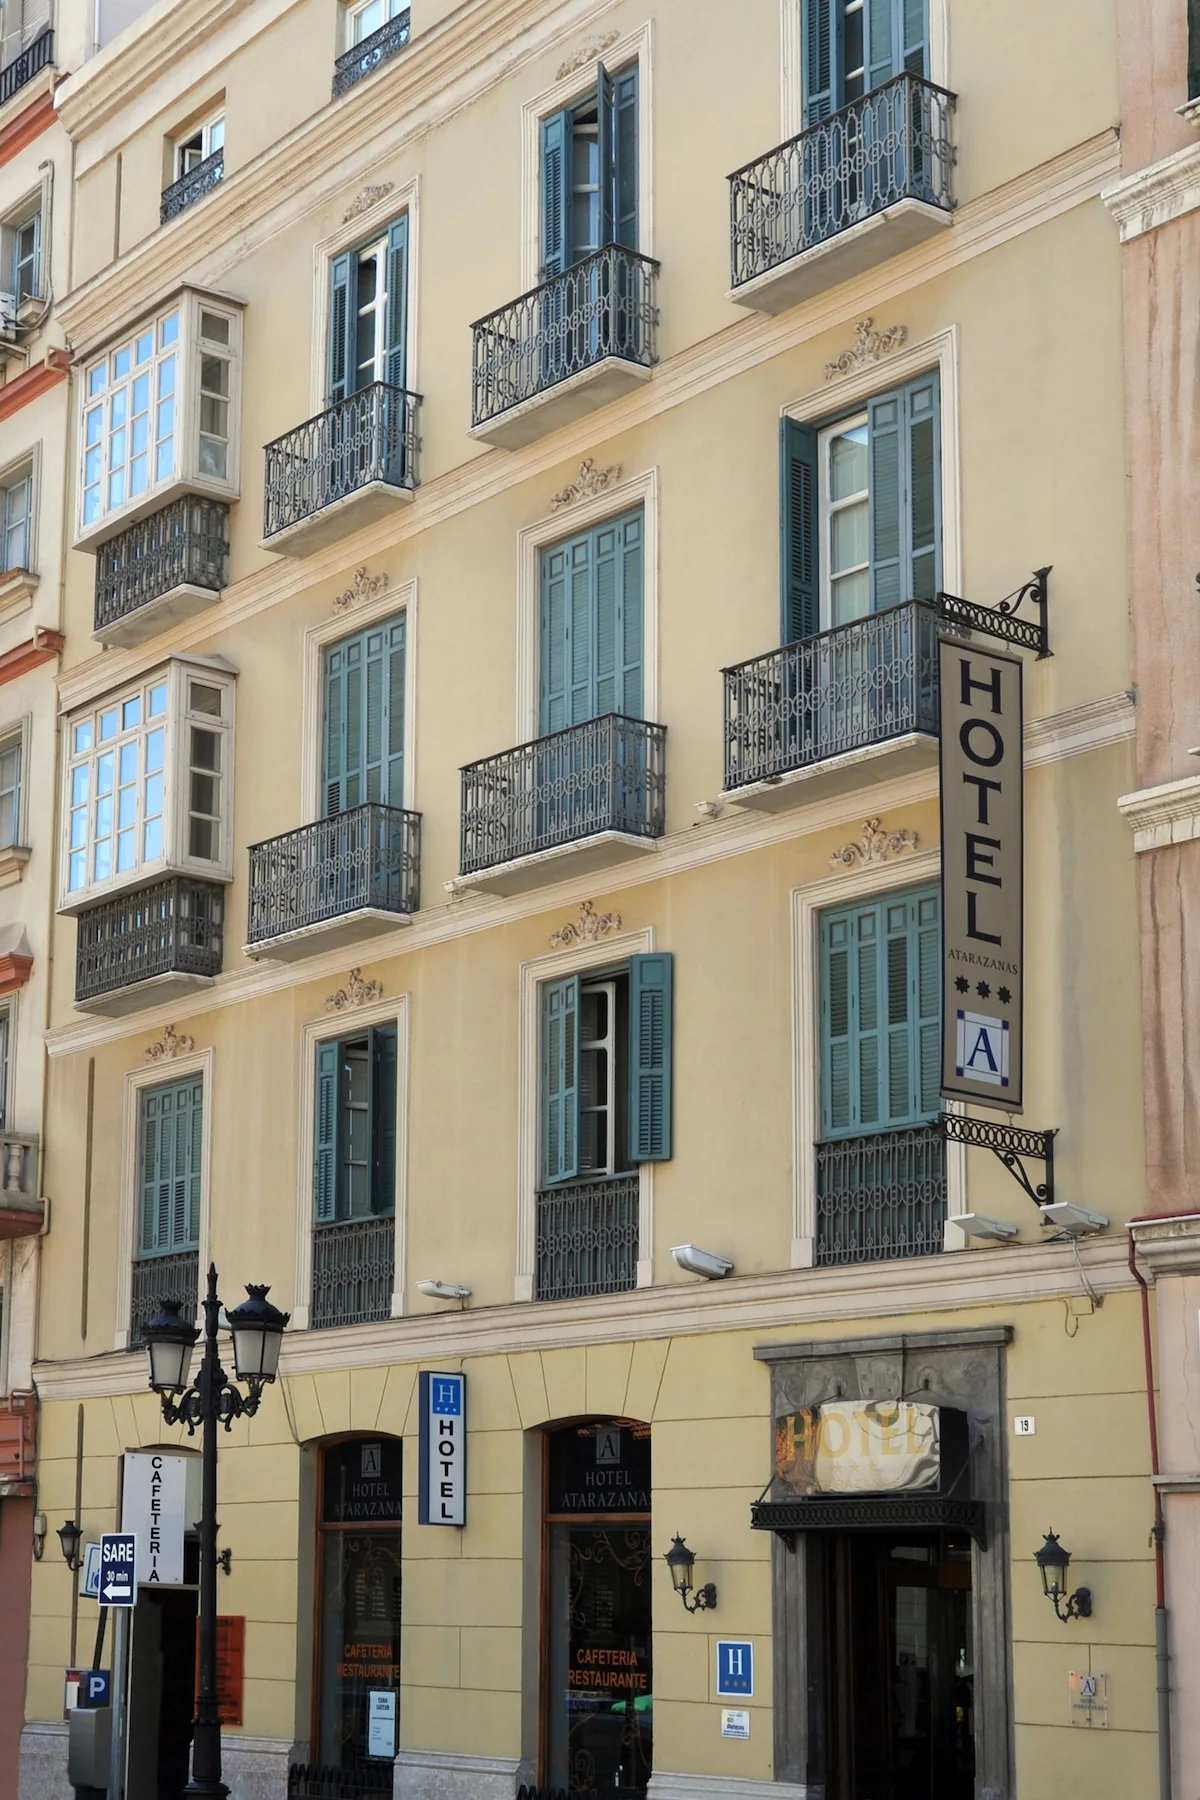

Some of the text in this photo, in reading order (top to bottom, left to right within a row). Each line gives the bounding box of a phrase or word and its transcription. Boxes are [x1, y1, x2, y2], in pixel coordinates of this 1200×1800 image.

[959, 658, 1004, 947] HOTEL
[948, 949, 1018, 975] ATARAZANAS
[966, 1027, 999, 1072] A
[438, 1384, 455, 1404] H
[786, 1408, 928, 1461] HOTEL
[1020, 1419, 1029, 1433] 19
[601, 1434, 615, 1457] A
[438, 1420, 455, 1519] HOTEL
[585, 1470, 631, 1486] HOTEL
[352, 1482, 389, 1498] HOTEL
[149, 1456, 162, 1582] CAFETERIA
[103, 1543, 133, 1563] SARE
[106, 1570, 129, 1582] 30 min
[344, 1643, 393, 1659] CAFETERIA
[577, 1648, 637, 1666] CAFETERIA
[728, 1648, 743, 1675] H
[336, 1663, 401, 1679] RESTAURANTE
[567, 1668, 647, 1689] RESTAURANTE
[89, 1676, 106, 1698] P
